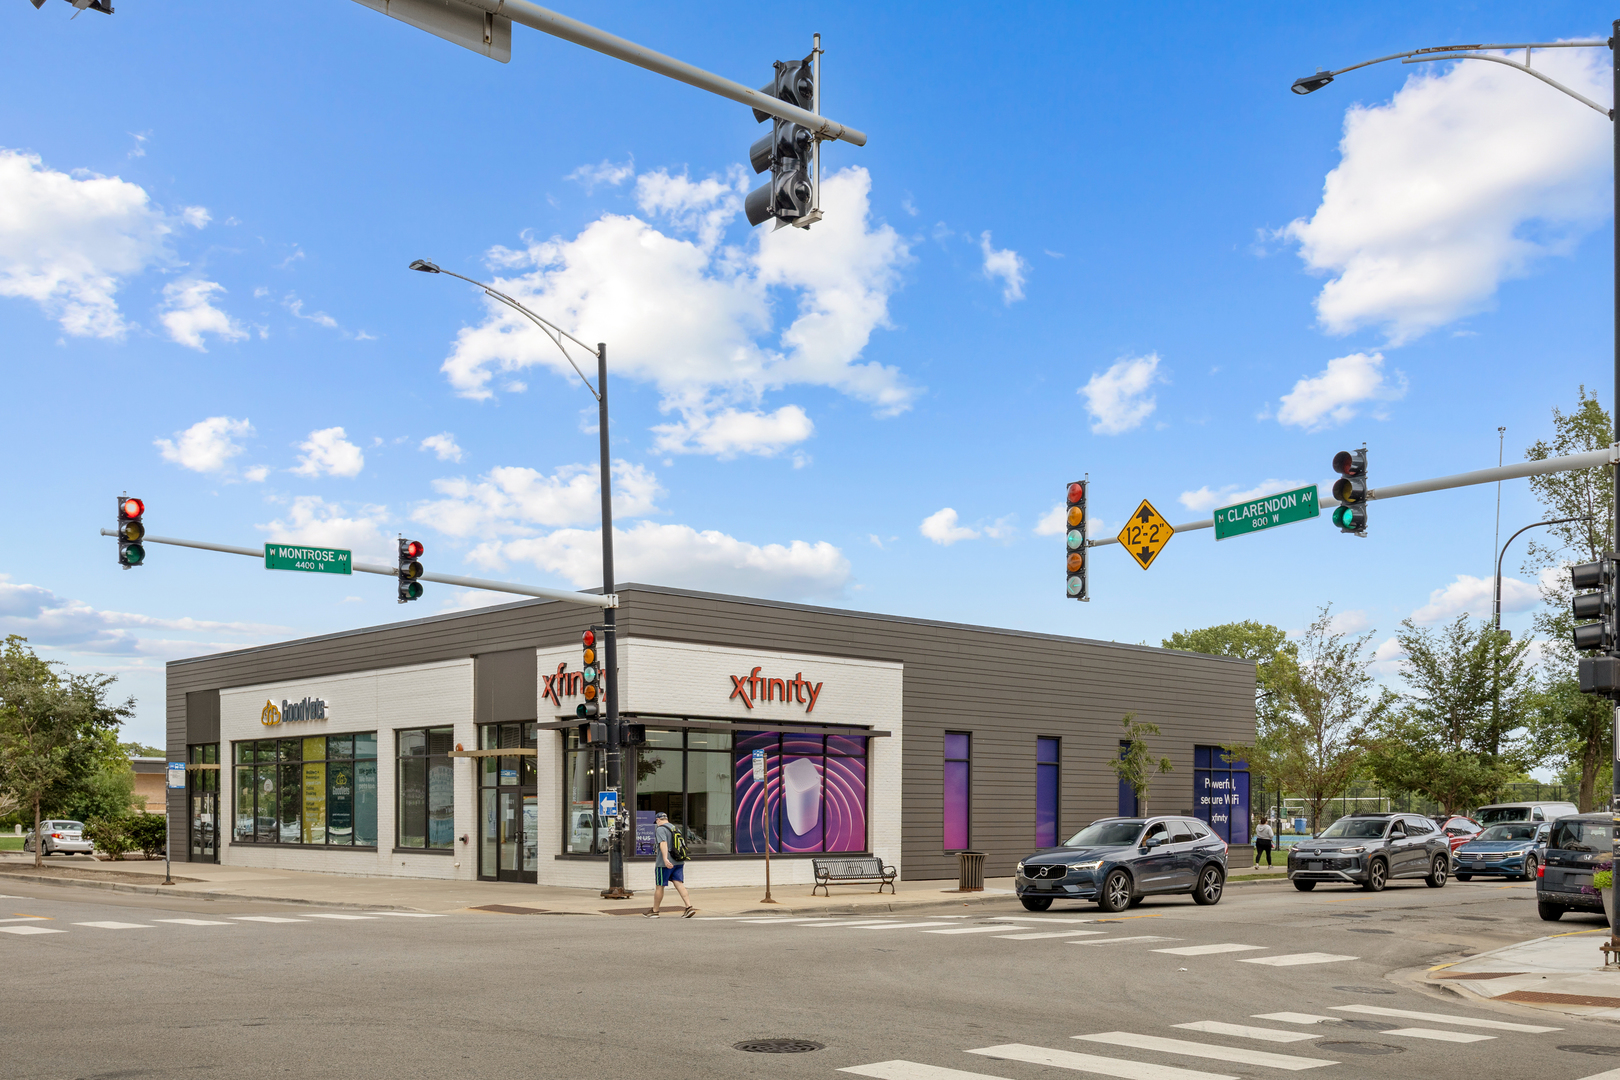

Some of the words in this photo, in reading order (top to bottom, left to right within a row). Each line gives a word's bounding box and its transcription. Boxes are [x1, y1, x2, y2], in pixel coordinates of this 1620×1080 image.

[1227, 494, 1297, 522] CLARENDON
[1301, 492, 1312, 503] AV
[1252, 516, 1268, 528] 800
[1272, 513, 1279, 523] W
[279, 547, 335, 562] MONTROSE
[295, 561, 315, 570] 4400
[729, 666, 824, 713] xfinity
[282, 697, 326, 722] GoodVets
[1211, 813, 1228, 824] xfinity
